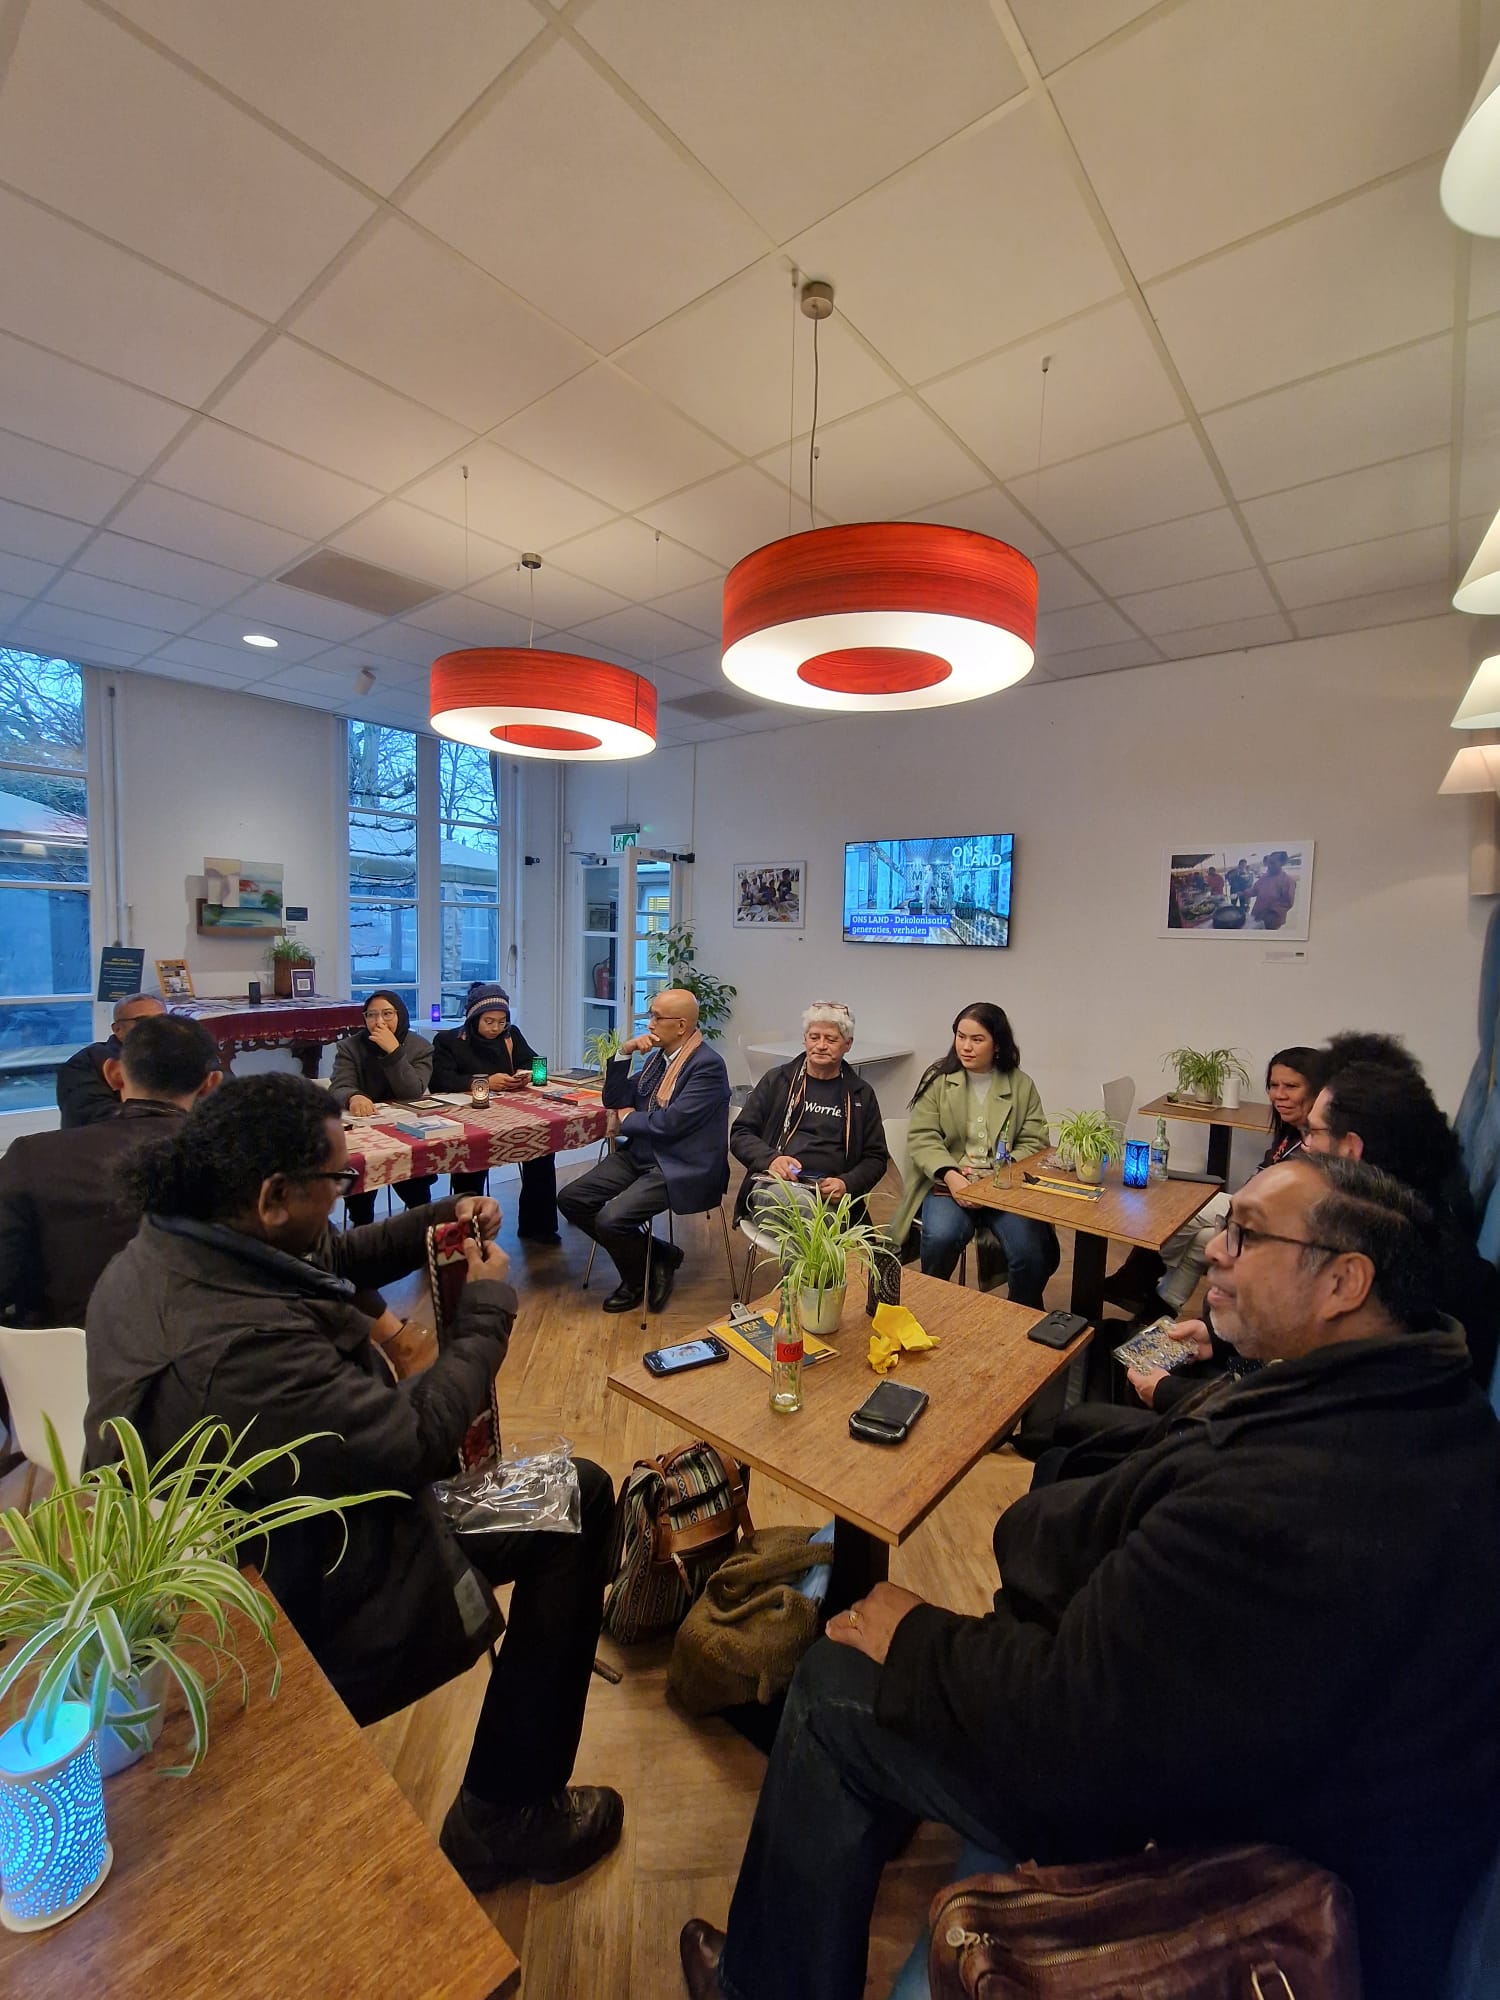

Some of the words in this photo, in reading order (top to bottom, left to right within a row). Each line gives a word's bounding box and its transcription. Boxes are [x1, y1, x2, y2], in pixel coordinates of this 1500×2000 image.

[952, 845, 982, 857] ONS
[963, 854, 1002, 867] LAND
[852, 915, 868, 924] ONS
[868, 915, 890, 924] LAND
[894, 915, 949, 926] Dekolonisatie,
[852, 925, 892, 935] generaties,
[892, 925, 927, 935] verhalen
